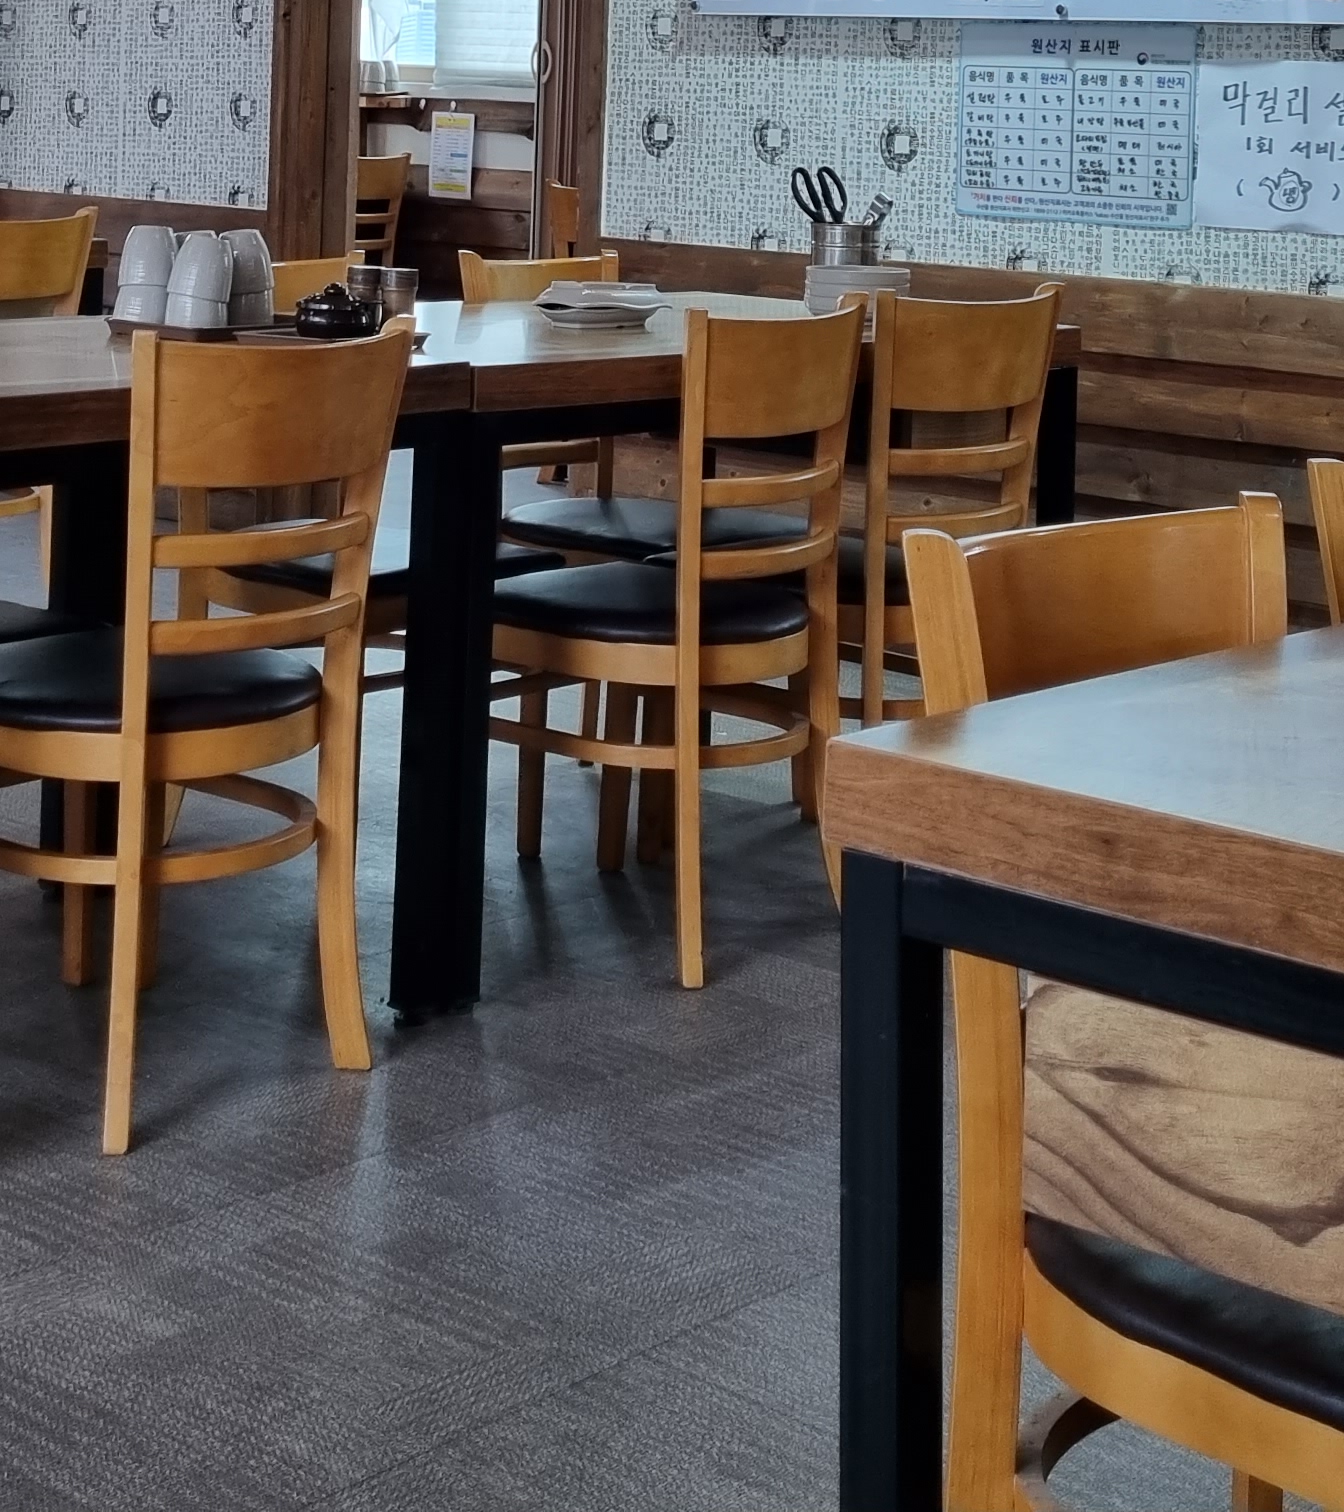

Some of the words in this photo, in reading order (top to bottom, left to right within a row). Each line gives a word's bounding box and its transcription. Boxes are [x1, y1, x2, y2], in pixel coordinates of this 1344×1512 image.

[1032, 38, 1072, 54] 원산지
[1079, 39, 1121, 56] 표시판
[1222, 80, 1309, 126] 막걸리
